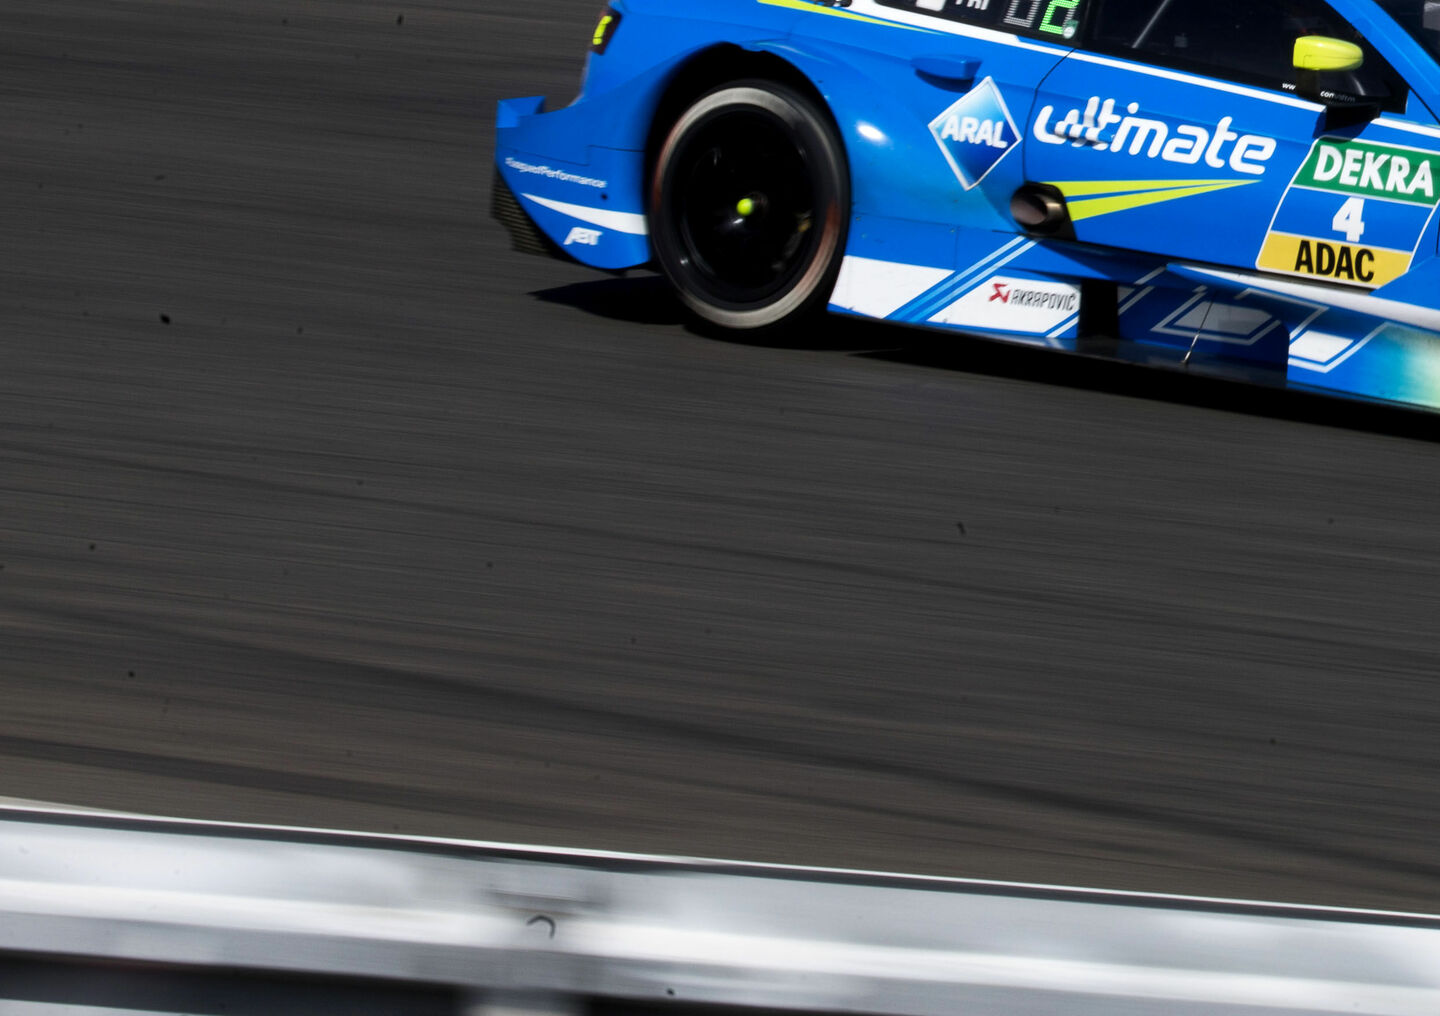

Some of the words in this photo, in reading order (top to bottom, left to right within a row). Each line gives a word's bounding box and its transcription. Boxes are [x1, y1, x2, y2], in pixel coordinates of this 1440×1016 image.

[940, 115, 1008, 149] ARAL
[1033, 95, 1277, 176] ultimate
[1313, 144, 1434, 198] DEKRA
[563, 227, 603, 245] ABT
[1332, 196, 1365, 243] 4
[1294, 240, 1375, 282] ADAC
